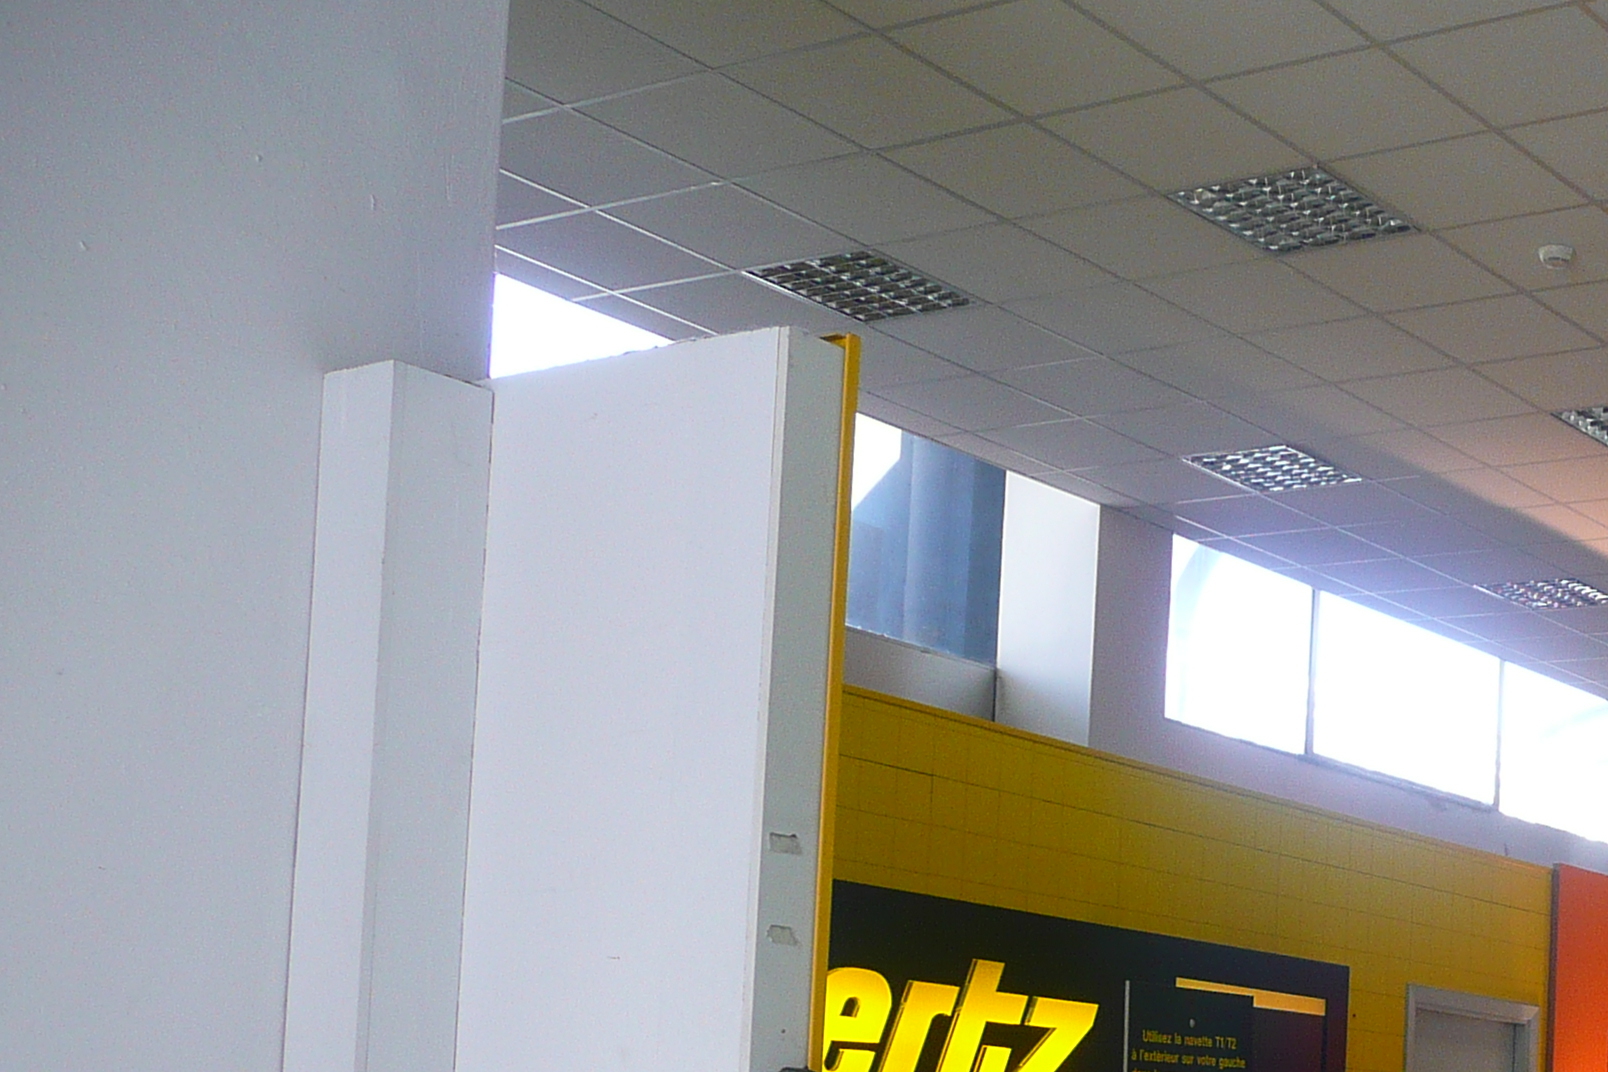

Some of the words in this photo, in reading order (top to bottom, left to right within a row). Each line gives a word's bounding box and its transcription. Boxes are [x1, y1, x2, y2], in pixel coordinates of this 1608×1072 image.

[1142, 1029, 1172, 1044] Utilisez
[1174, 1032, 1183, 1045] la
[1184, 1035, 1213, 1048] navette
[1215, 1036, 1237, 1050] T1/T2
[1131, 1048, 1137, 1061] à
[1181, 1054, 1195, 1065] sur
[1197, 1055, 1216, 1067] votre
[1218, 1056, 1246, 1070] gauche
